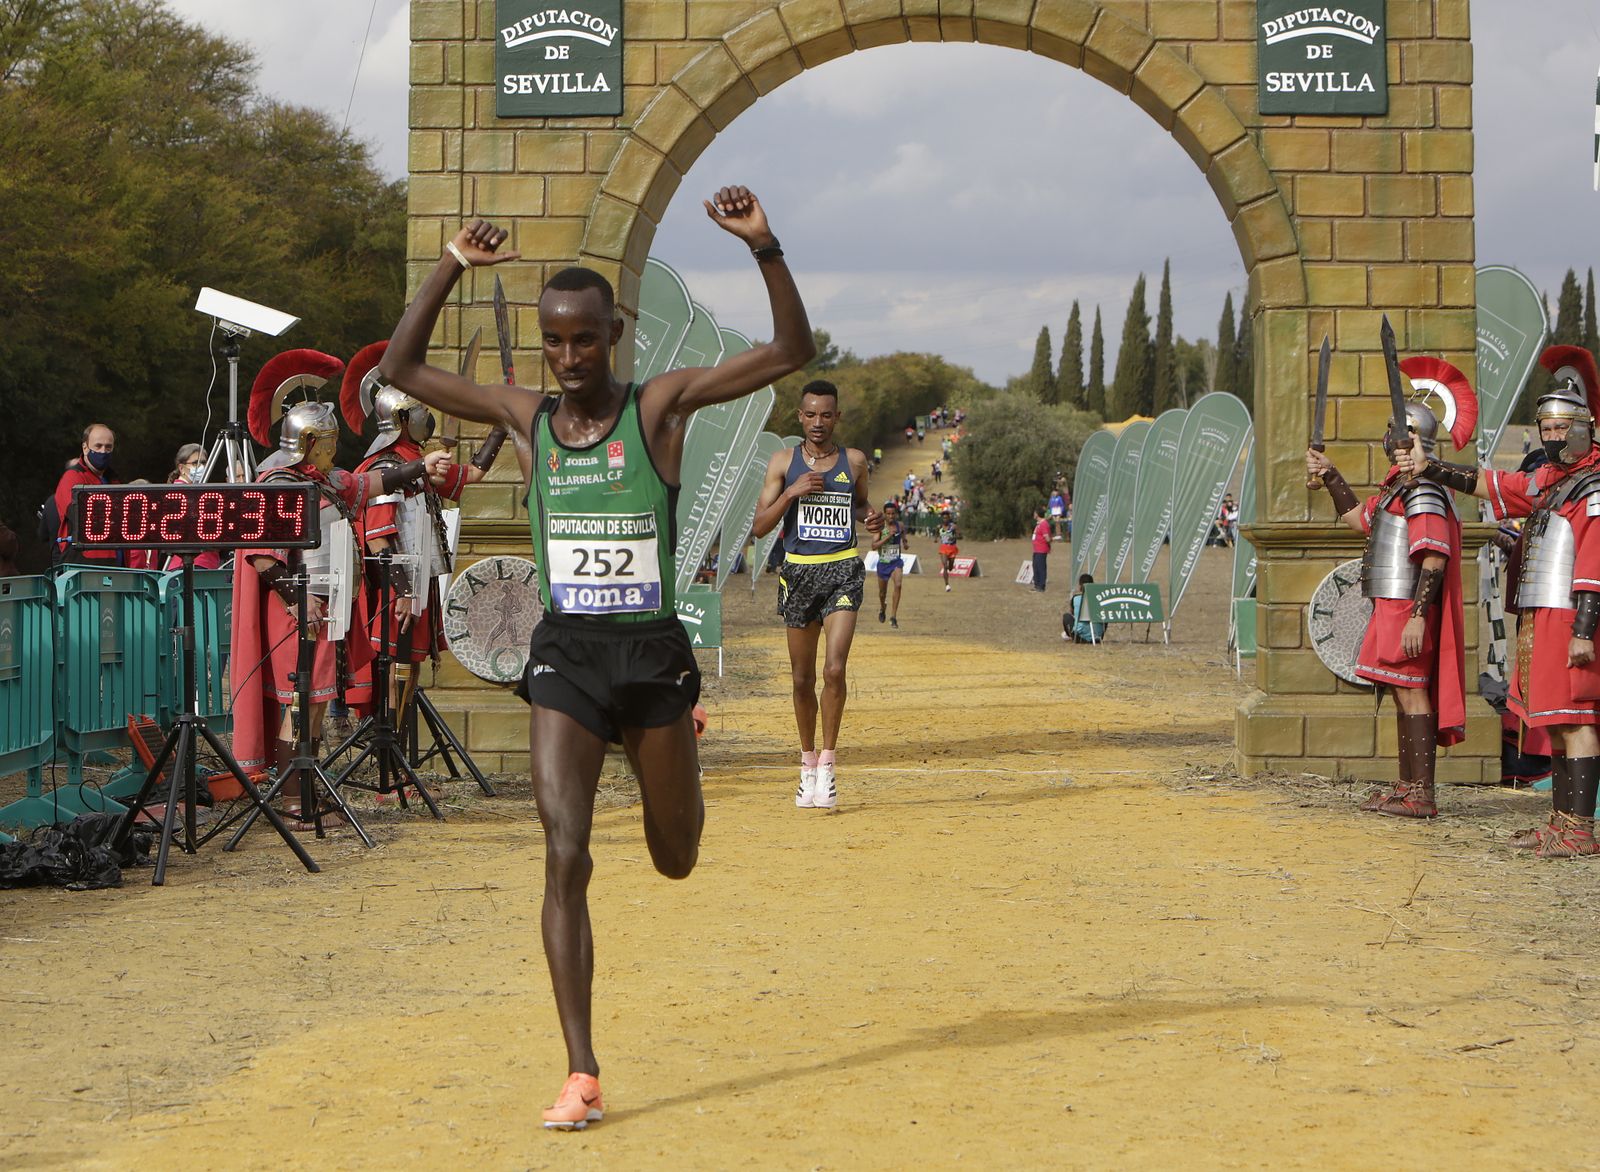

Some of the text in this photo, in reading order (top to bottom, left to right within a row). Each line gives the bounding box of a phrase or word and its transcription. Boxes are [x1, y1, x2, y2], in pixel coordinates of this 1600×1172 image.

[501, 9, 618, 42] DIPUTACION
[1262, 8, 1380, 38] DIPUTACION
[544, 45, 570, 60] DE
[1306, 45, 1333, 59] DE
[503, 72, 611, 95] SEVILLA
[1265, 72, 1376, 93] SEVILLA
[548, 473, 606, 486] VILLARREAL
[688, 451, 727, 522] ITÁLICA
[84, 491, 304, 541] 00:28:34
[550, 516, 655, 535] DIPUTACION DE SEVILLA
[803, 506, 848, 526] WORKU
[1141, 496, 1173, 573] CROSS ITÁL
[1179, 481, 1225, 577] CROSS ITÁLICA
[726, 534, 745, 562] CROSS
[1113, 537, 1129, 570] CROSS
[572, 548, 635, 577] 252
[1096, 587, 1152, 602] DIPUTACION
[1099, 610, 1153, 620] SEVILLA
